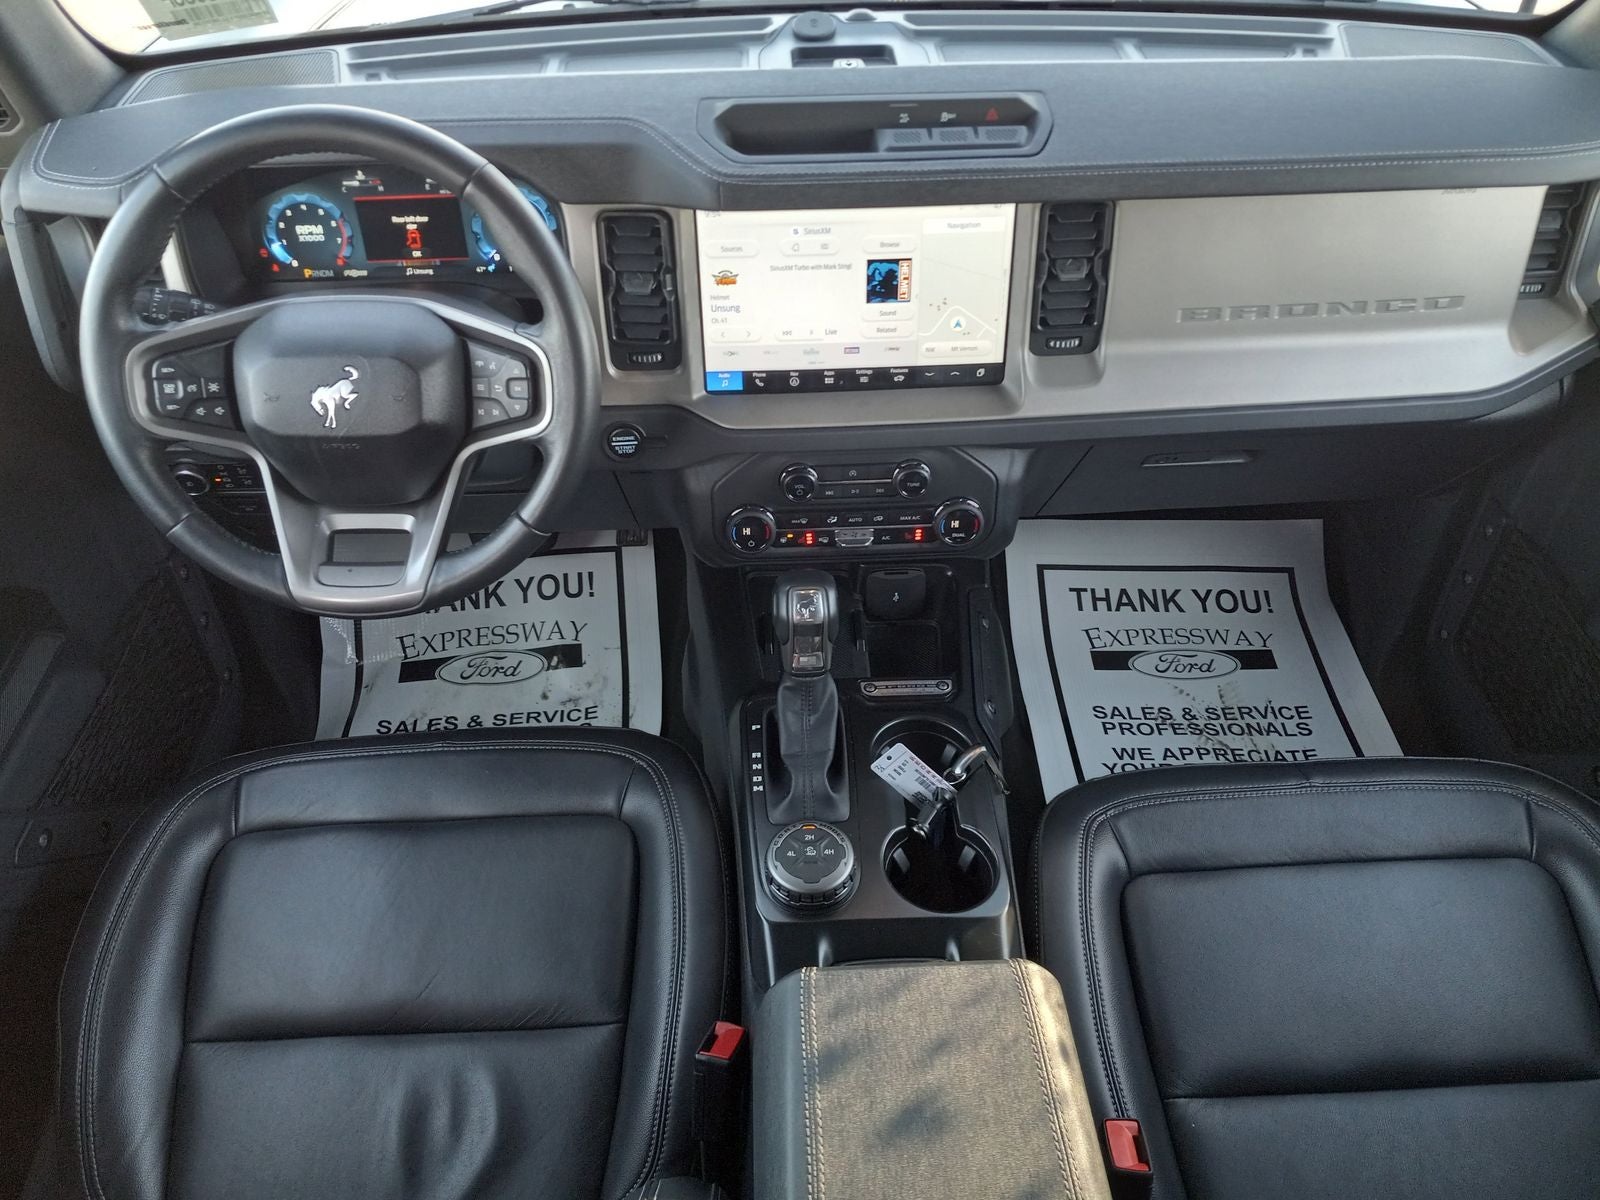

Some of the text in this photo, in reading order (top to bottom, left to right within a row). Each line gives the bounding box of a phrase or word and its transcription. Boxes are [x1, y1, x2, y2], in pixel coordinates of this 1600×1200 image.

[295, 224, 324, 235] RPM
[803, 227, 831, 235] SiriusXM
[947, 222, 981, 230] Navigation
[899, 261, 910, 300] HELMET
[711, 304, 741, 313] Unsung
[1176, 295, 1466, 323] BRONCO
[825, 328, 838, 336] Live
[742, 527, 751, 535] HI
[950, 520, 960, 528] HI
[514, 571, 595, 604] YOU!
[1069, 587, 1274, 614] THANK YOU!
[395, 620, 588, 661] EXPRESSWAY
[1081, 627, 1273, 649] EXPRESSWAY
[459, 655, 522, 680] Ford
[1155, 653, 1216, 674] Ford
[376, 705, 599, 735] SALES & SERVICE
[1092, 704, 1313, 721] SALES & SERVICE
[1101, 721, 1313, 737] PROFESSIONALS
[1112, 747, 1318, 763] WE APPRECIATE
[1101, 762, 1173, 775] YO
